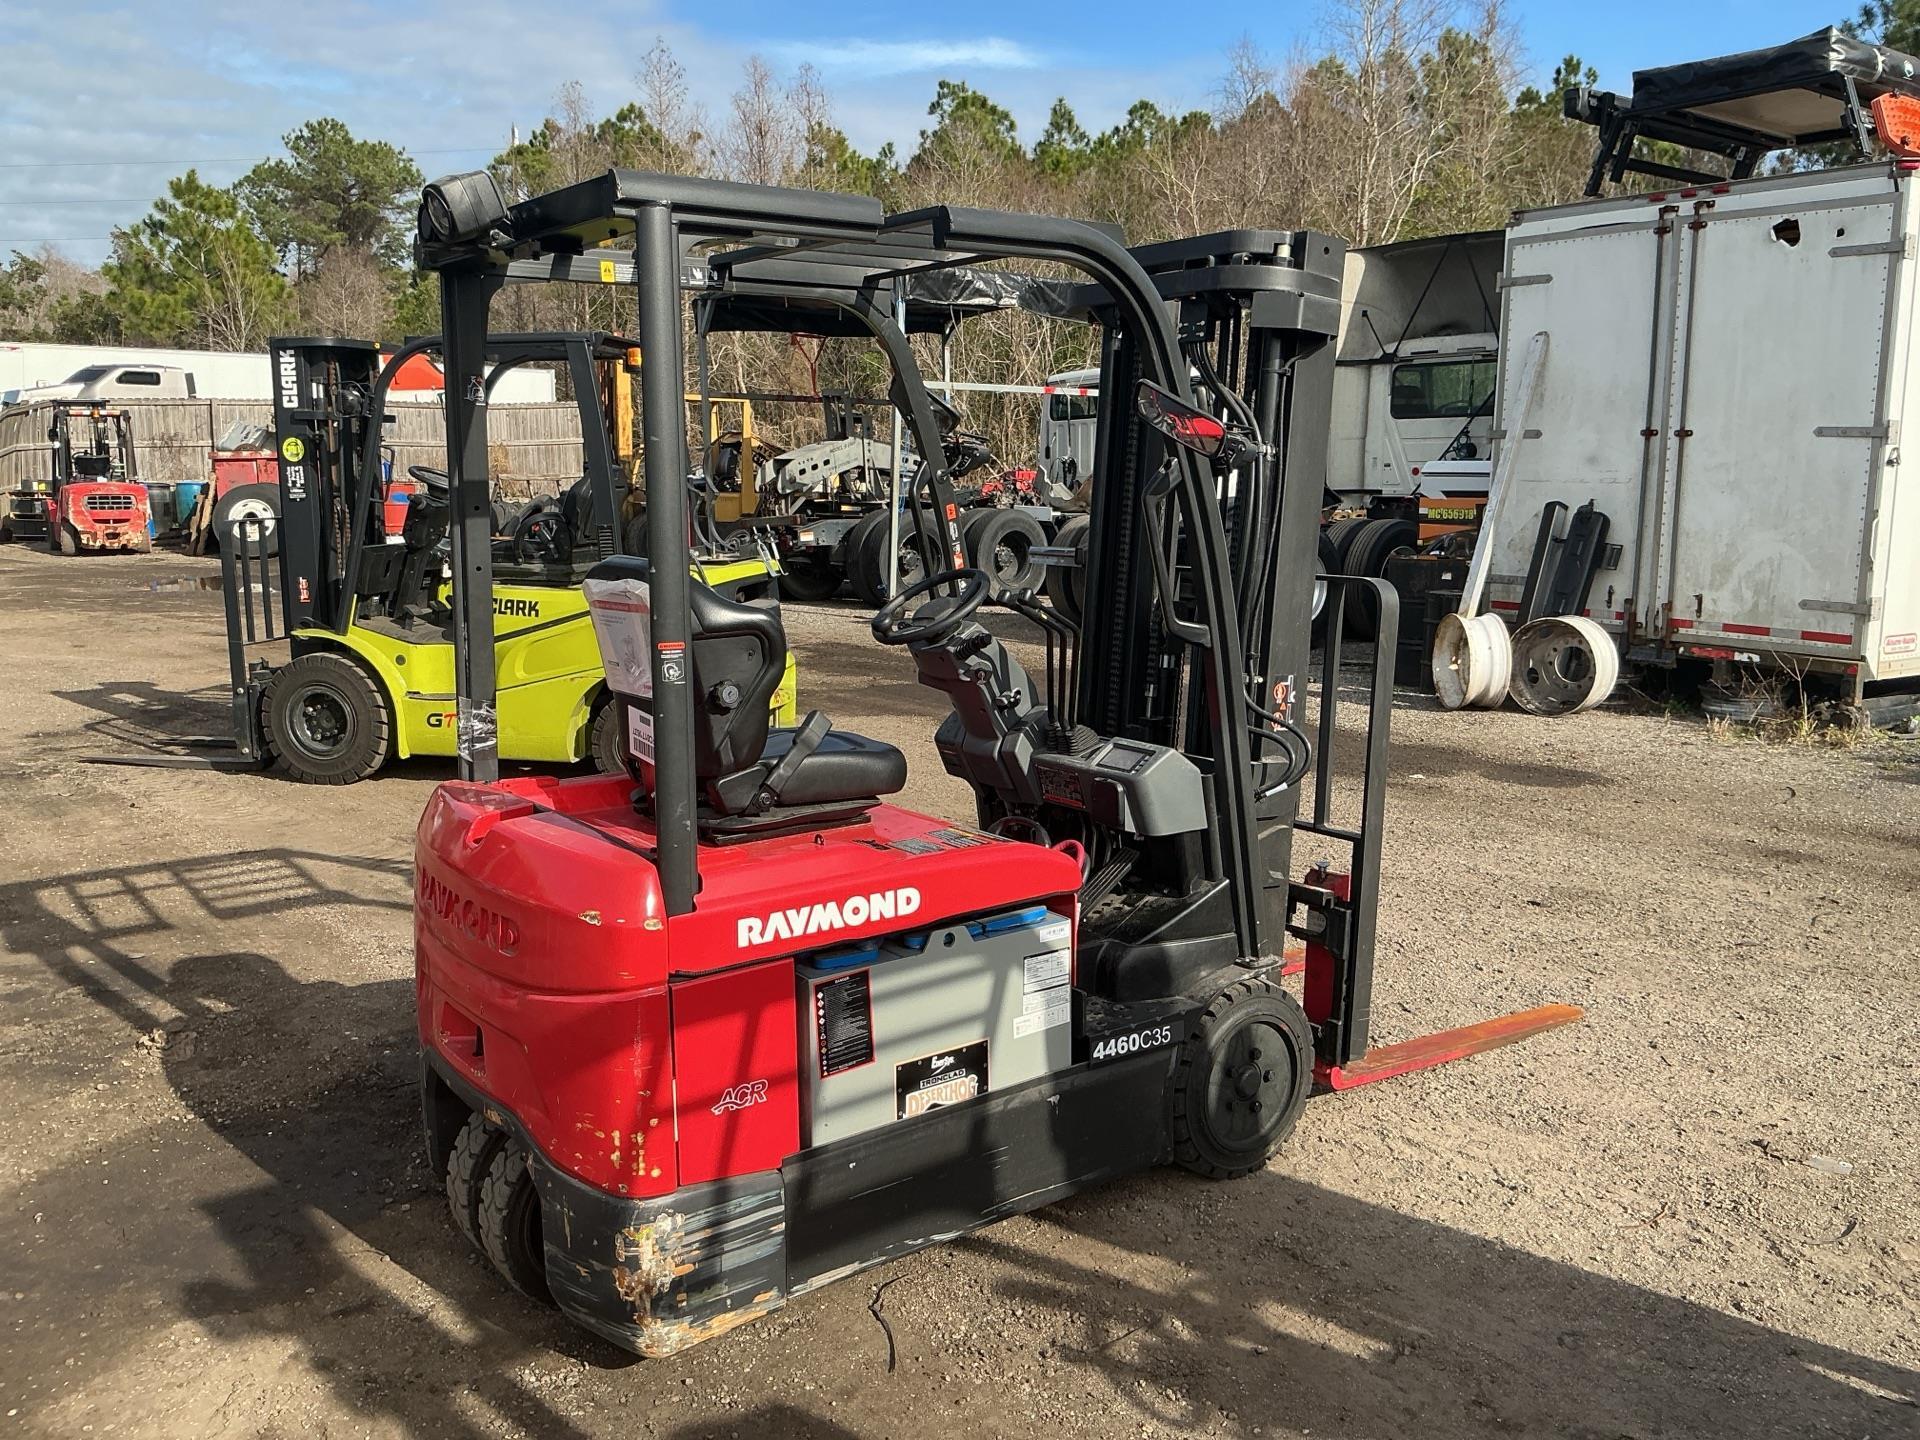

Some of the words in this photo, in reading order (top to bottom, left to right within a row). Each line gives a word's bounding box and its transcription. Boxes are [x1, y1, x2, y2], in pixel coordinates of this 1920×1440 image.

[280, 349, 299, 408] CLARK
[420, 865, 520, 957] RAYMOND
[737, 886, 921, 948] RAYMOND
[1092, 1025, 1171, 1060] 4460C35
[711, 1079, 769, 1115] ACR
[921, 1069, 966, 1088] IRONCLAD
